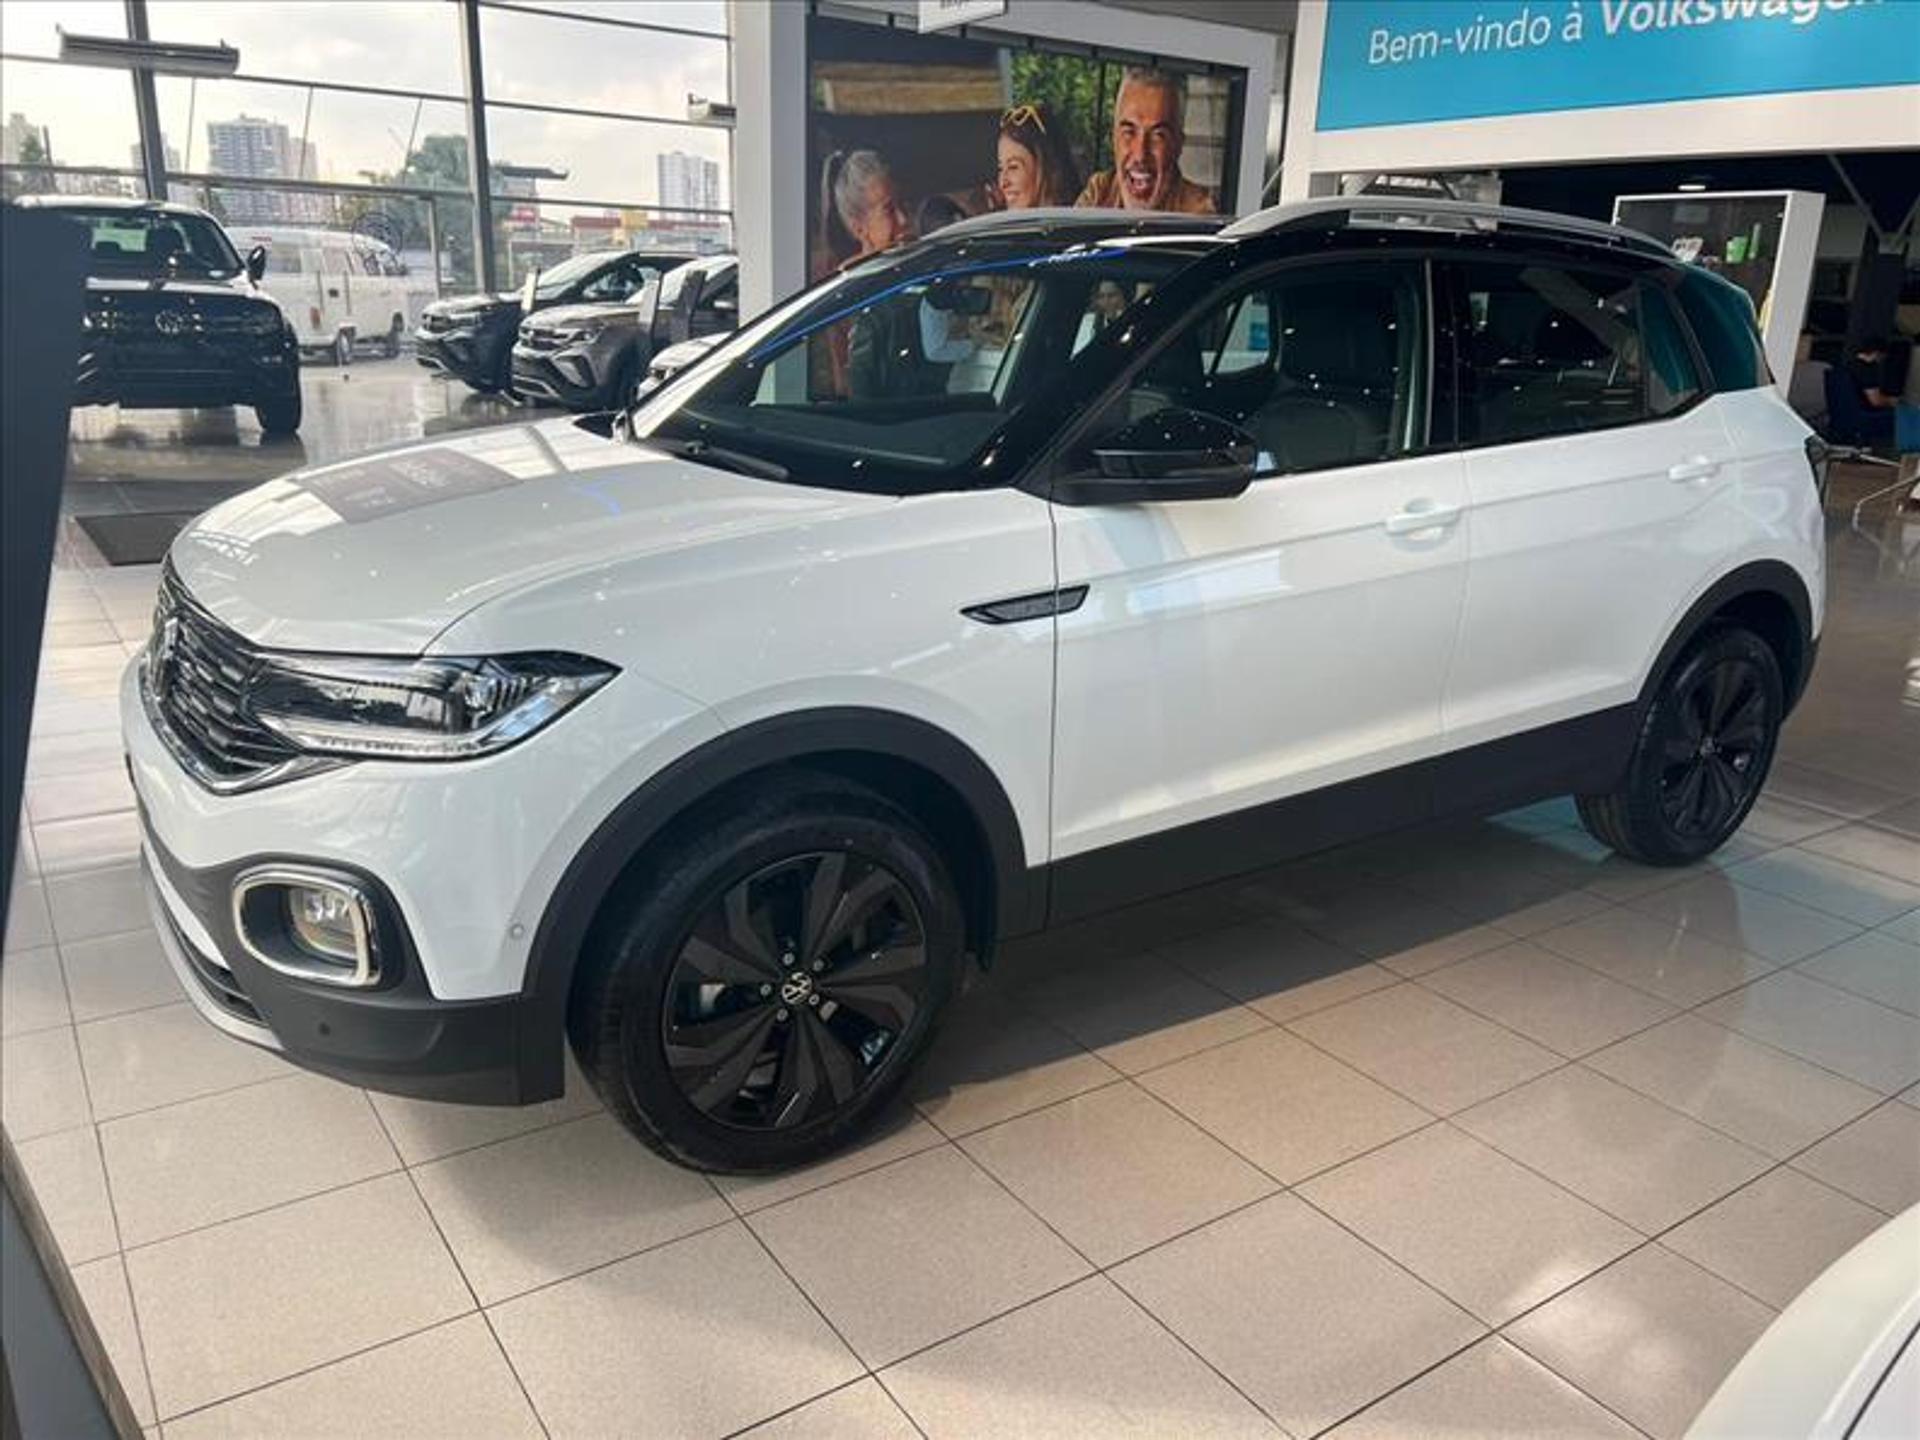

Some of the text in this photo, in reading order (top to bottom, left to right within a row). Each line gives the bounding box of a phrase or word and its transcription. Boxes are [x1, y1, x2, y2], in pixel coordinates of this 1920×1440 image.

[1368, 0, 1883, 64] Bem-vindo à Volkswag
